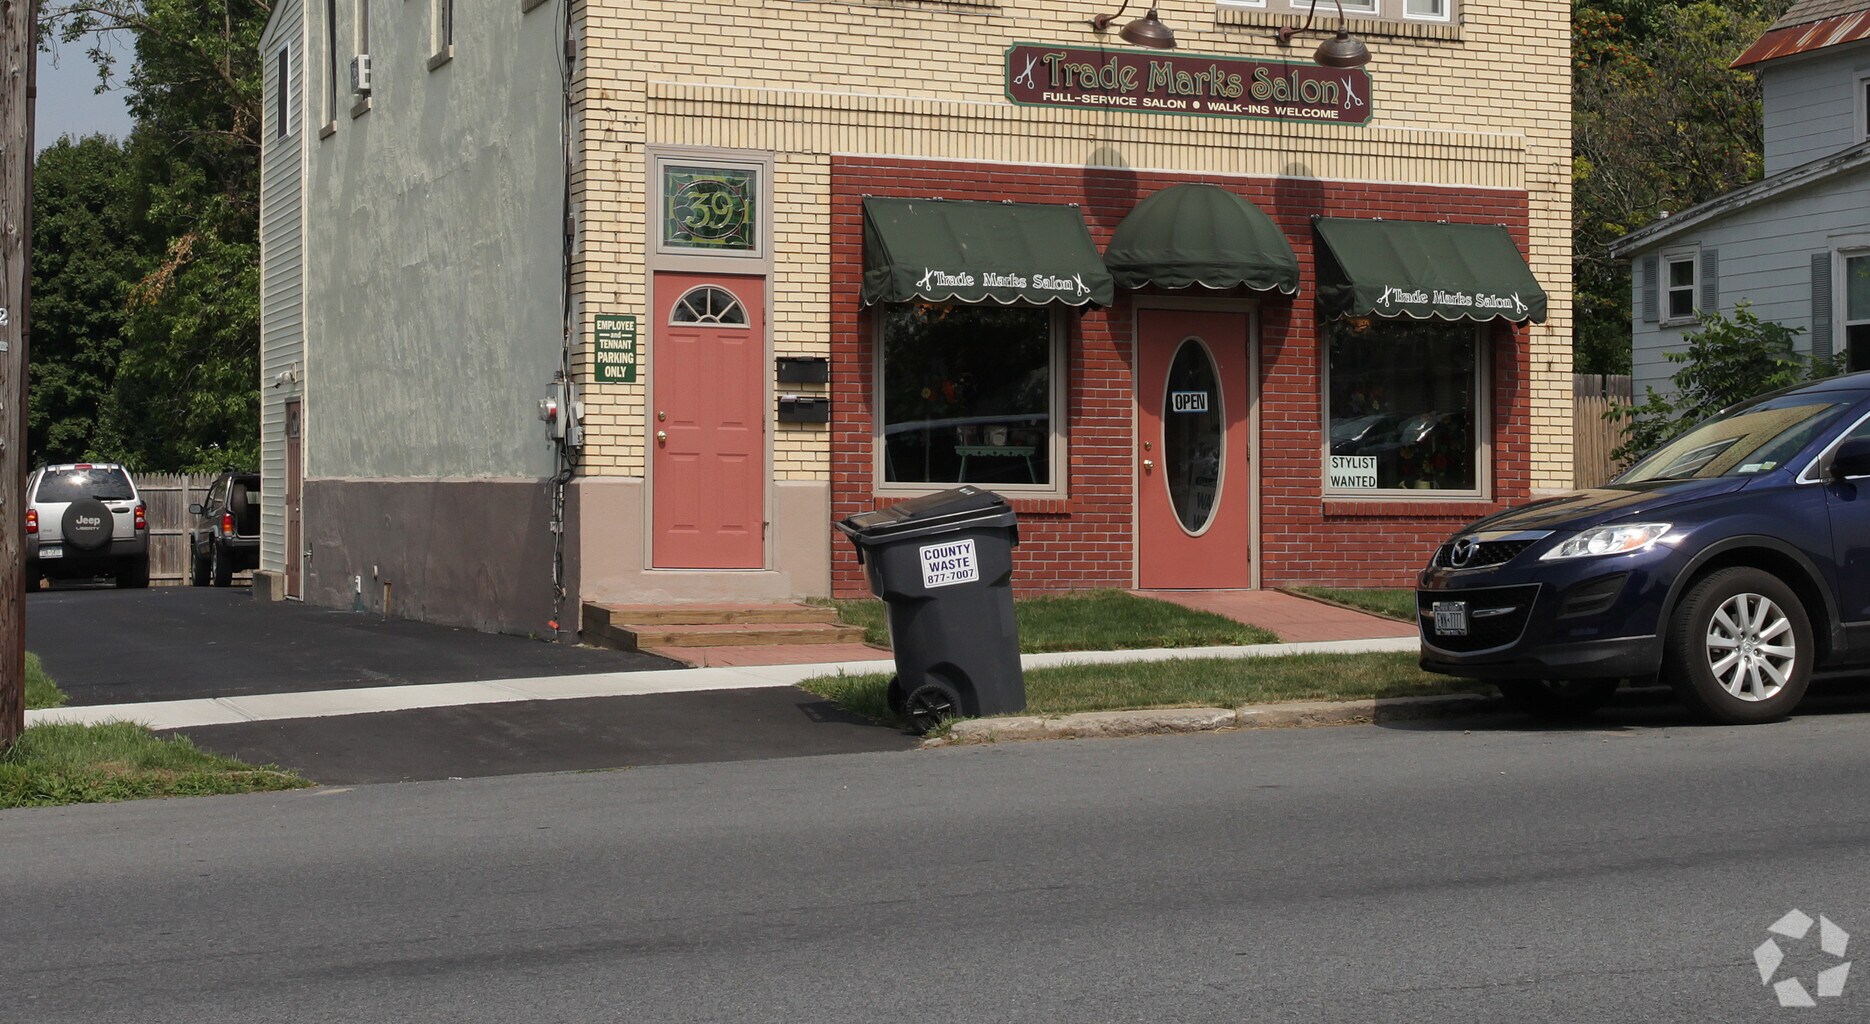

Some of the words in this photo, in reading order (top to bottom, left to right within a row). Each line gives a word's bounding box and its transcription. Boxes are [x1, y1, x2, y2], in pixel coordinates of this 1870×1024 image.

[1043, 51, 1139, 94] Trade
[1147, 60, 1244, 97] Marks
[1251, 67, 1340, 105] Salon
[1042, 91, 1138, 107] FULL-SERVICE
[1142, 97, 1187, 109] SALON
[1207, 101, 1270, 115] WALK-INS
[1274, 106, 1340, 119] WELCOME
[685, 191, 734, 229] 39
[934, 271, 975, 287] Trade
[982, 272, 1027, 289] Marks
[1032, 274, 1074, 291] Salon
[1392, 288, 1429, 304] Trade
[1432, 290, 1473, 307] Marks
[1475, 293, 1514, 309] Salon
[596, 320, 635, 331] EMPLOYEE
[610, 331, 622, 339] and
[599, 339, 633, 350] TENNANT
[597, 351, 634, 364] PARKING
[604, 365, 627, 378] ONLY
[1175, 393, 1206, 410] OPEN
[1331, 456, 1376, 469] STYLIST
[1330, 475, 1377, 488] WANTED
[75, 515, 101, 527] Jeep
[923, 543, 971, 561] COUNTY
[928, 556, 971, 573] WASTE
[927, 568, 974, 584] 877-7007
